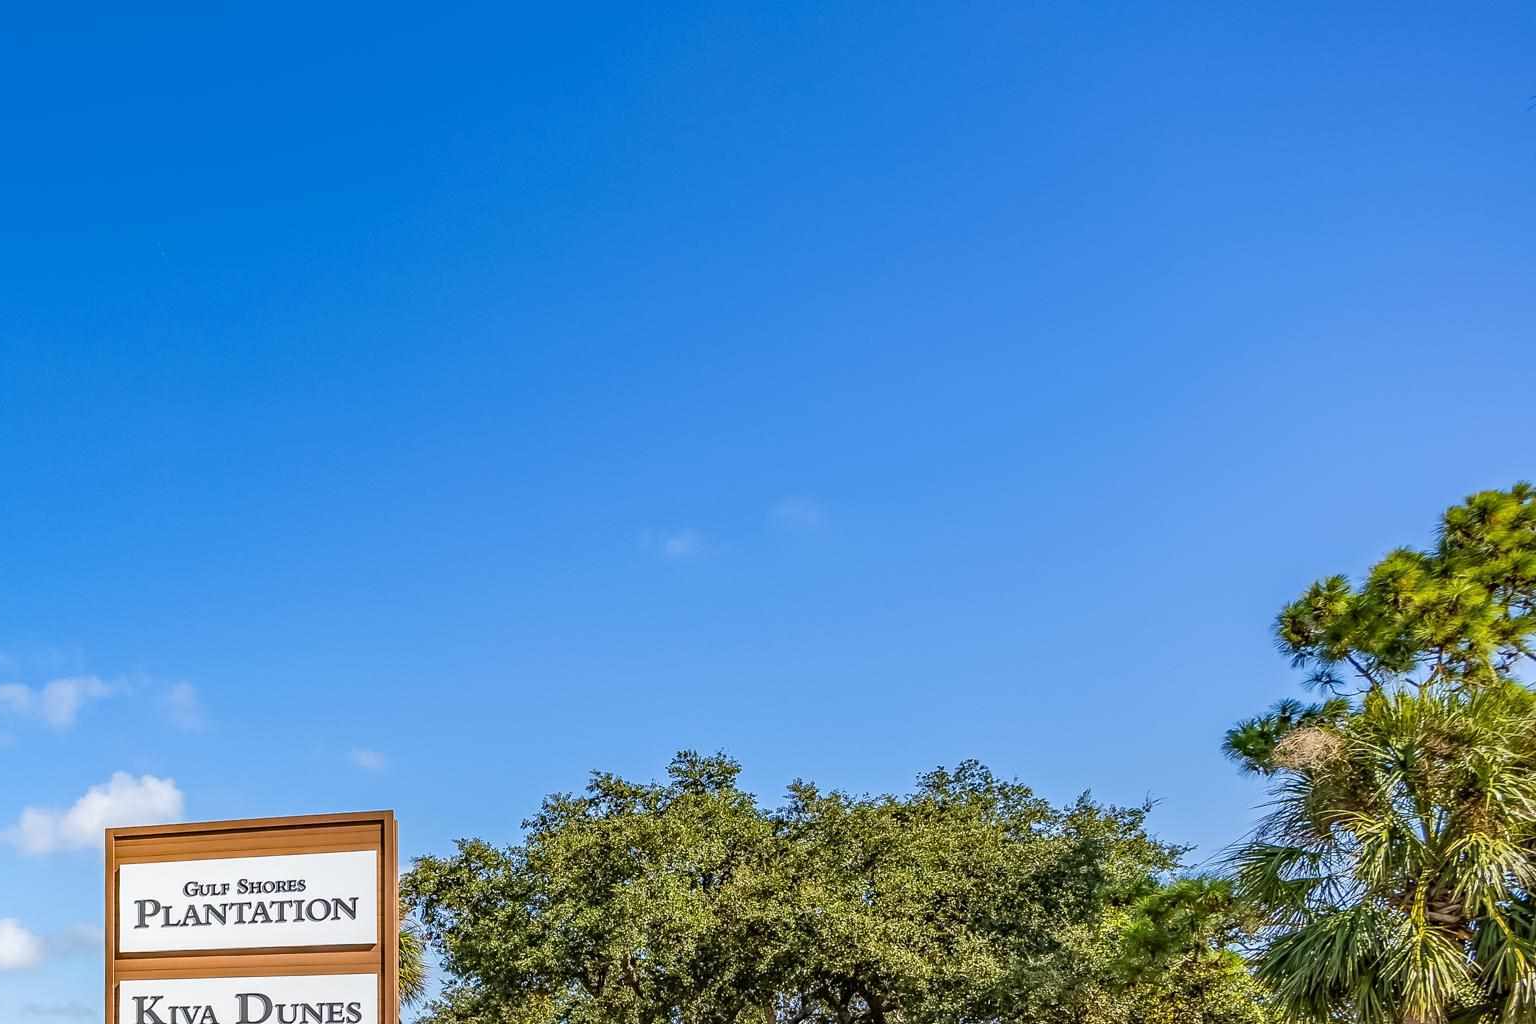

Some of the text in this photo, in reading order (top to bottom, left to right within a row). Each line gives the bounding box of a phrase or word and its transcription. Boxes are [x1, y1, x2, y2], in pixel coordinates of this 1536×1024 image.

[183, 879, 306, 897] GULF SHORES
[134, 897, 359, 929] PLANTATION
